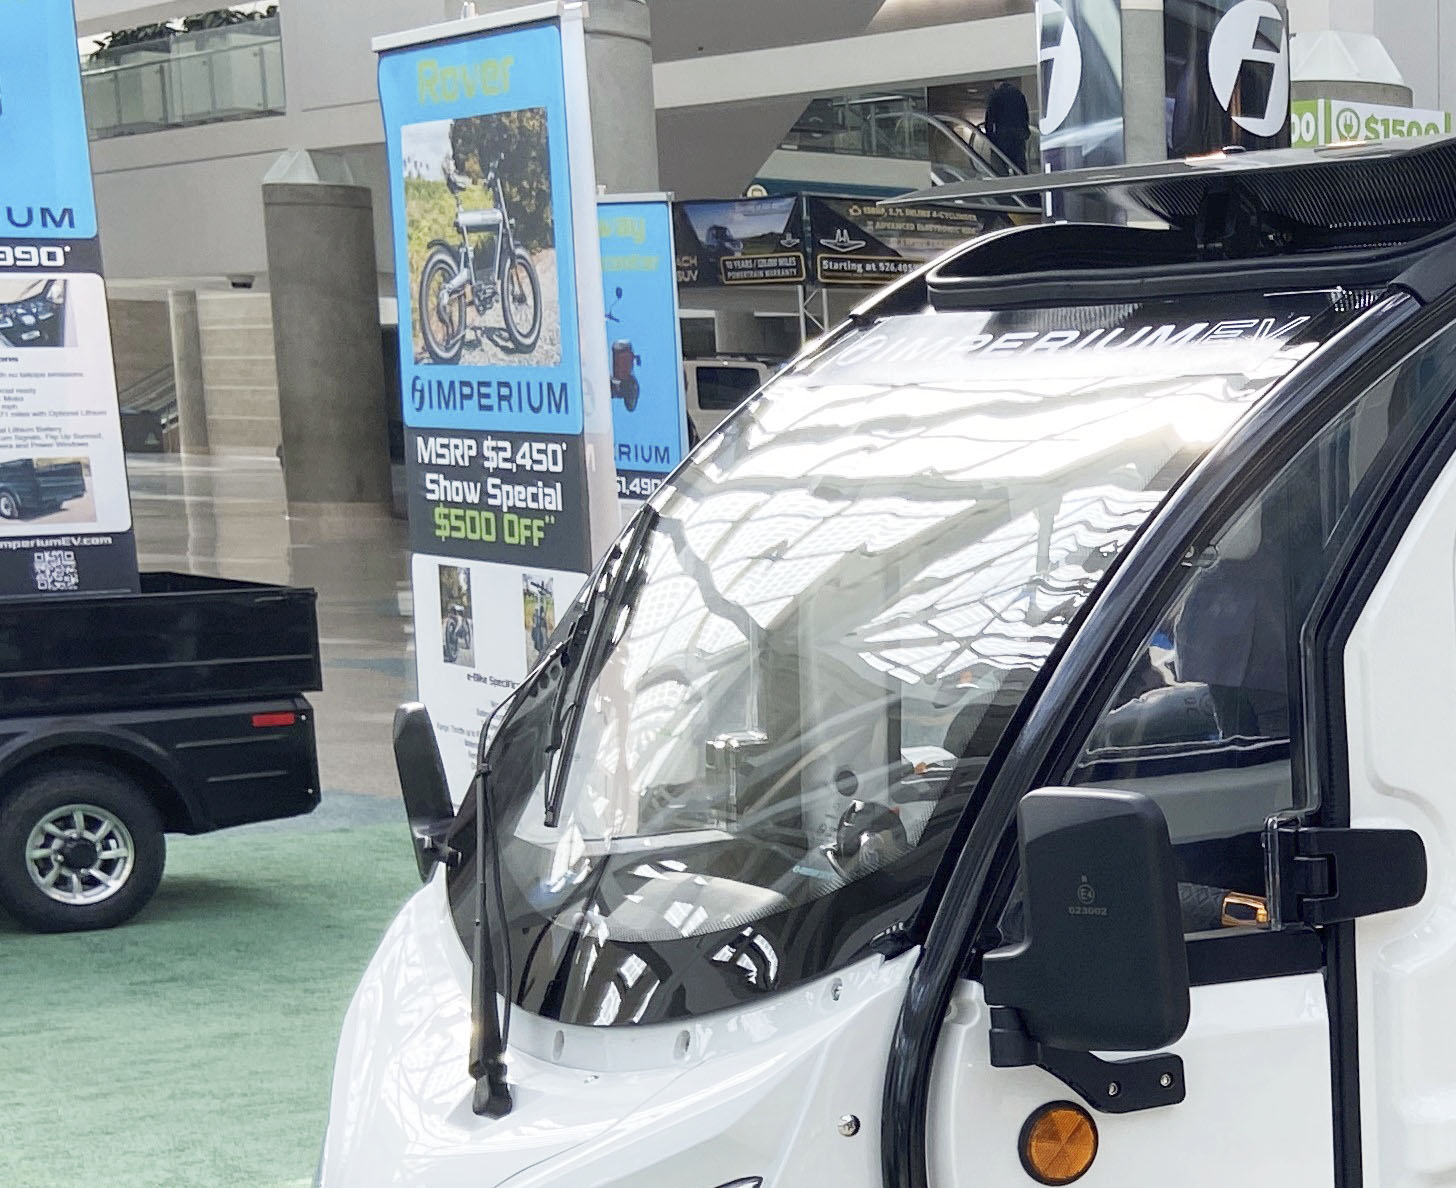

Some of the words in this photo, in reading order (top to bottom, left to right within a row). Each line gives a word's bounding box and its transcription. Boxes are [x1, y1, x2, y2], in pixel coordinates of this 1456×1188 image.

[417, 56, 514, 104] Rover
[822, 260, 863, 273] Starting
[865, 262, 877, 271] at
[428, 379, 569, 415] IMPERIUM
[416, 435, 478, 467] MSRP
[614, 443, 670, 465] RIUM
[425, 472, 481, 504] Show
[486, 477, 563, 512] Special
[434, 502, 497, 542] $500
